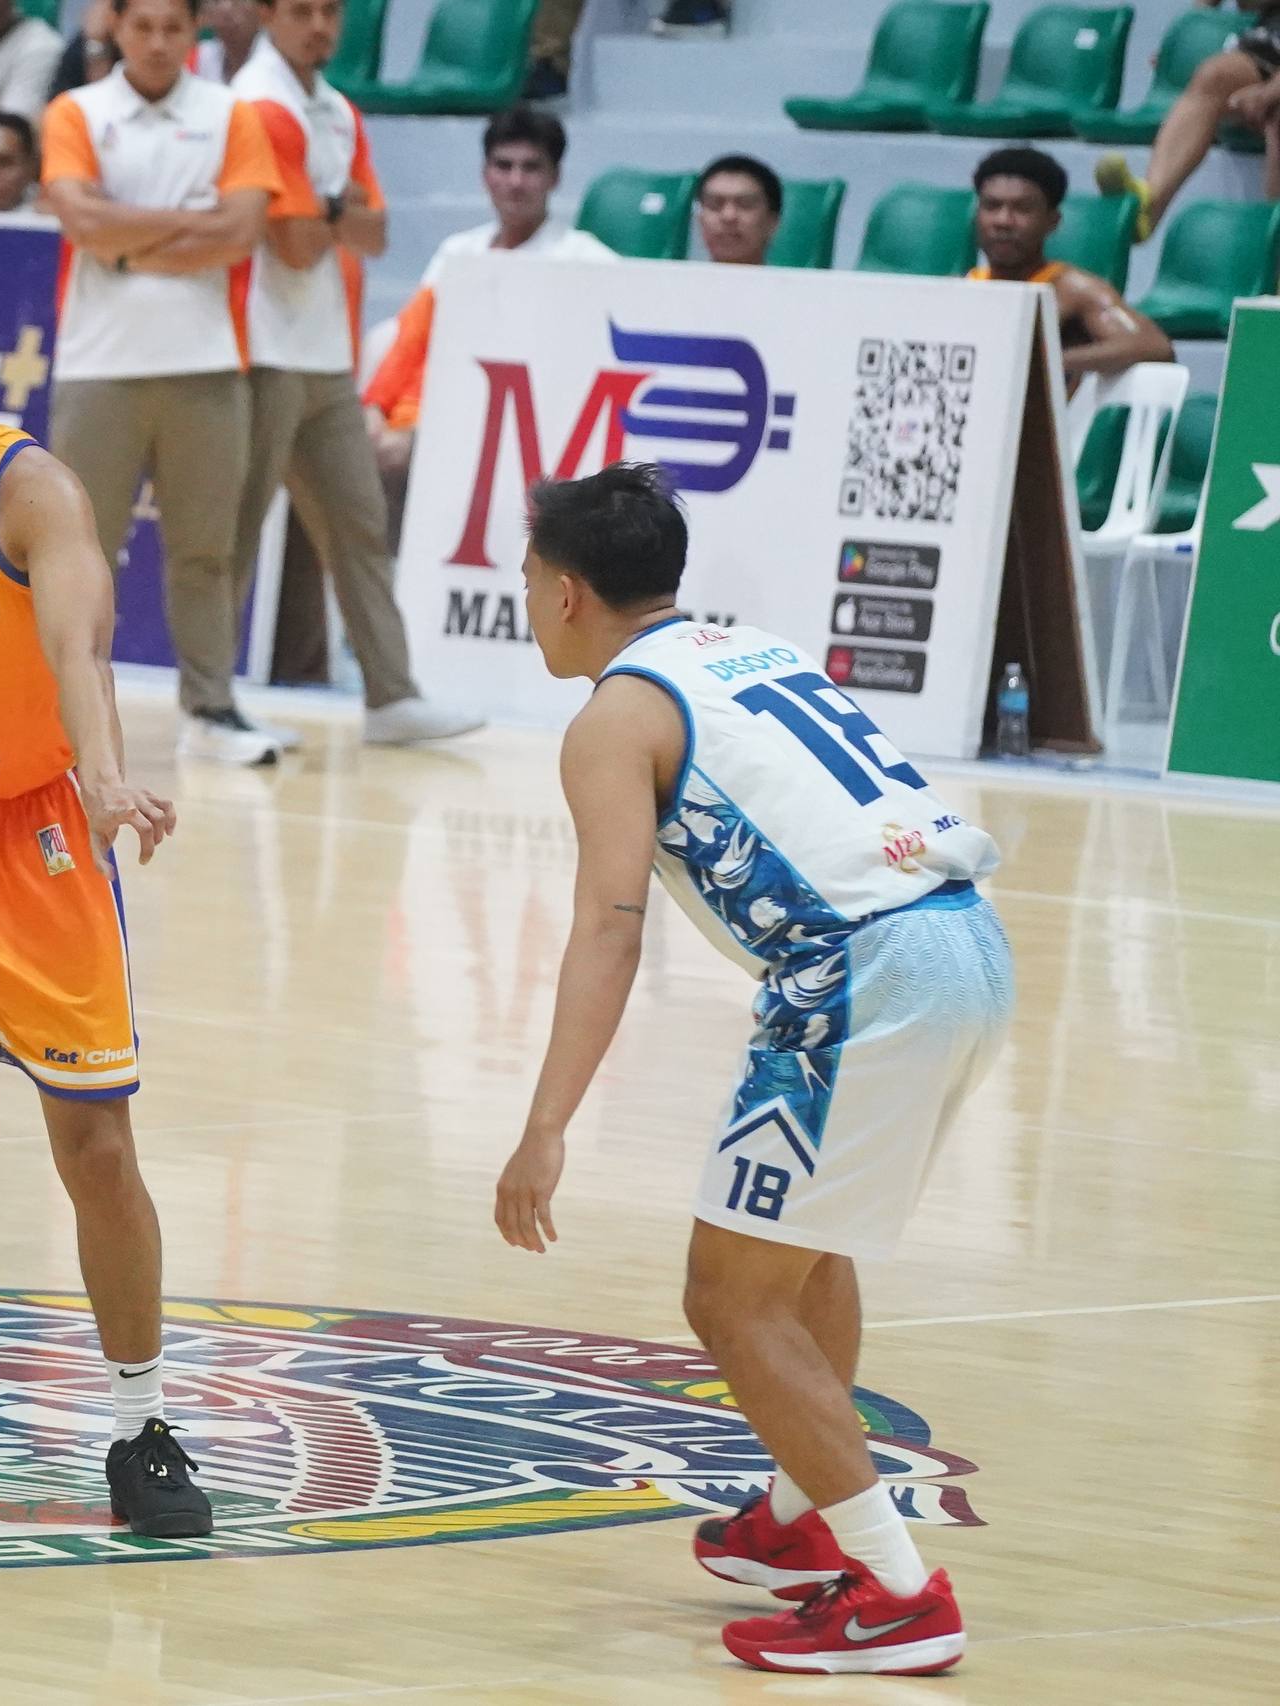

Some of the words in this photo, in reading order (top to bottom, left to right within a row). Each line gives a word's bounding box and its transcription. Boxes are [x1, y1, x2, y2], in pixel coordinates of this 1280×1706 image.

[703, 647, 800, 682] DESOYO
[44, 1046, 79, 1065] Kat
[726, 1155, 792, 1221] 18
